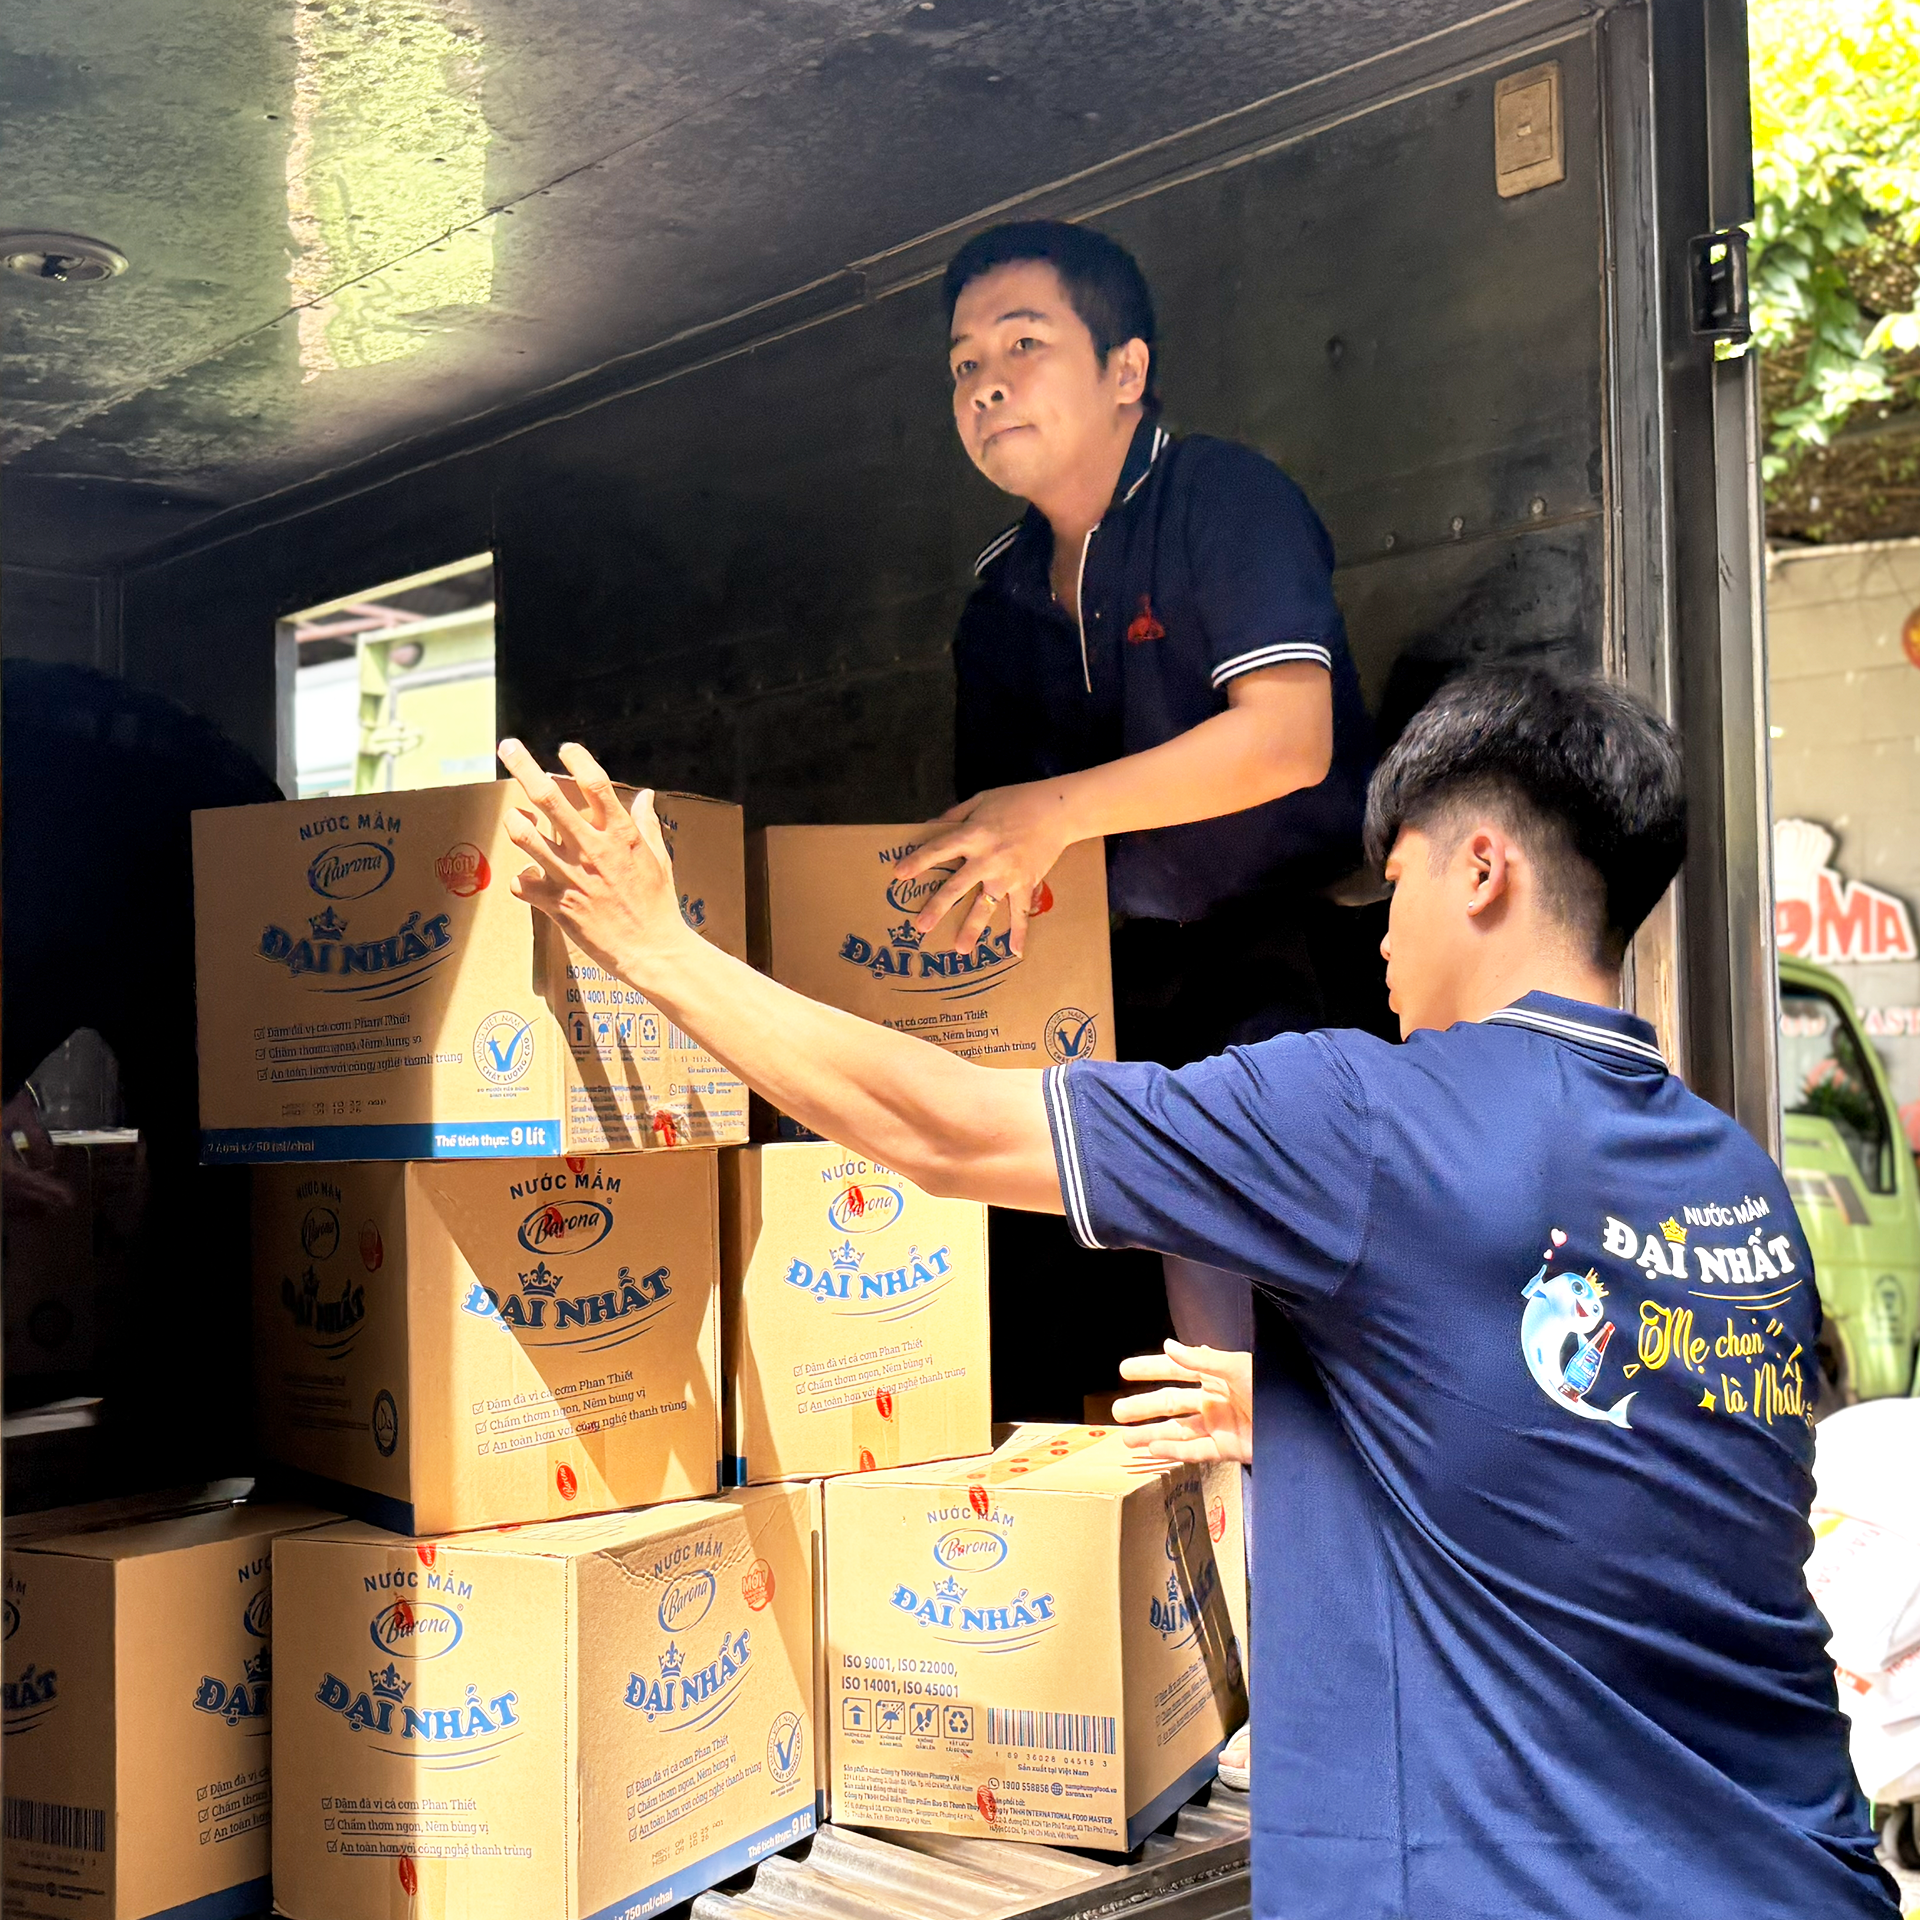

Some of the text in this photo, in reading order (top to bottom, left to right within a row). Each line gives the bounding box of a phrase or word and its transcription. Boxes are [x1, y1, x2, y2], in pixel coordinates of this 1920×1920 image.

[838, 934, 912, 980] ĐẠI
[567, 966, 580, 980] ISO
[567, 989, 580, 1002] ISO
[610, 990, 622, 1004] ISO
[511, 1127, 523, 1146] 9
[526, 1127, 545, 1145] lít
[510, 1168, 621, 1199] NƯỚC MẮM
[822, 1160, 866, 1183] NƯỚC
[1683, 1195, 1770, 1227] NƯỚC MẮM
[528, 1211, 600, 1244] Barona
[1602, 1216, 1796, 1284] ĐẠI NHẤT
[784, 1245, 952, 1302] ĐẠI NHẤT
[461, 1267, 672, 1333] ĐẠI NHẤT
[1638, 1300, 1765, 1375] Mẹ chọn
[860, 1350, 878, 1362] cơm
[879, 1344, 900, 1357] Phan
[902, 1338, 923, 1352] Thiết
[555, 1370, 634, 1396] cơm Phan Thiết
[834, 1374, 856, 1386] thơm
[1722, 1373, 1748, 1414] là
[523, 1411, 550, 1425] thơm
[927, 1504, 1015, 1528] NƯỚC MẮM
[654, 1544, 690, 1578] NƯỚC
[940, 1538, 996, 1561] Barona
[364, 1568, 473, 1600] NƯỚC MẮM
[664, 1580, 708, 1623] Barona
[889, 1583, 1054, 1632] ĐẠI NHẤT
[380, 1612, 450, 1644] Barona
[624, 1629, 751, 1722] ĐẠI NHẤT
[843, 1654, 958, 1677] ISO 9001, ISO 22000,
[842, 1676, 958, 1698] ISO 14001, ISO 45001
[192, 1675, 271, 1726] ĐẠI
[315, 1673, 519, 1742] ĐẠI NHẤT
[210, 1780, 232, 1798] Đậm
[234, 1774, 246, 1790] đà
[212, 1798, 240, 1817] Chấm
[360, 1798, 372, 1809] đà
[373, 1800, 382, 1811] vị
[384, 1798, 396, 1810] cá
[398, 1800, 419, 1810] cơm
[422, 1800, 448, 1810] Phan
[450, 1799, 476, 1810] Thiết
[214, 1824, 228, 1838] An
[338, 1819, 366, 1830] Chấm
[368, 1820, 394, 1831] thơm
[426, 1820, 448, 1832] Nêm
[451, 1820, 476, 1834] bùng
[478, 1822, 488, 1834] vị
[792, 1818, 799, 1835] 9
[800, 1812, 812, 1832] lít
[689, 1832, 698, 1841] 10
[689, 1839, 698, 1849] 10
[340, 1842, 354, 1852] An
[356, 1842, 377, 1852] toàn
[380, 1842, 398, 1853] hơn
[418, 1845, 442, 1857] công
[444, 1844, 469, 1857] nghệ
[472, 1845, 502, 1856] thanh
[504, 1845, 532, 1858] trùng
[625, 1887, 673, 1920] 750 ml/chai
